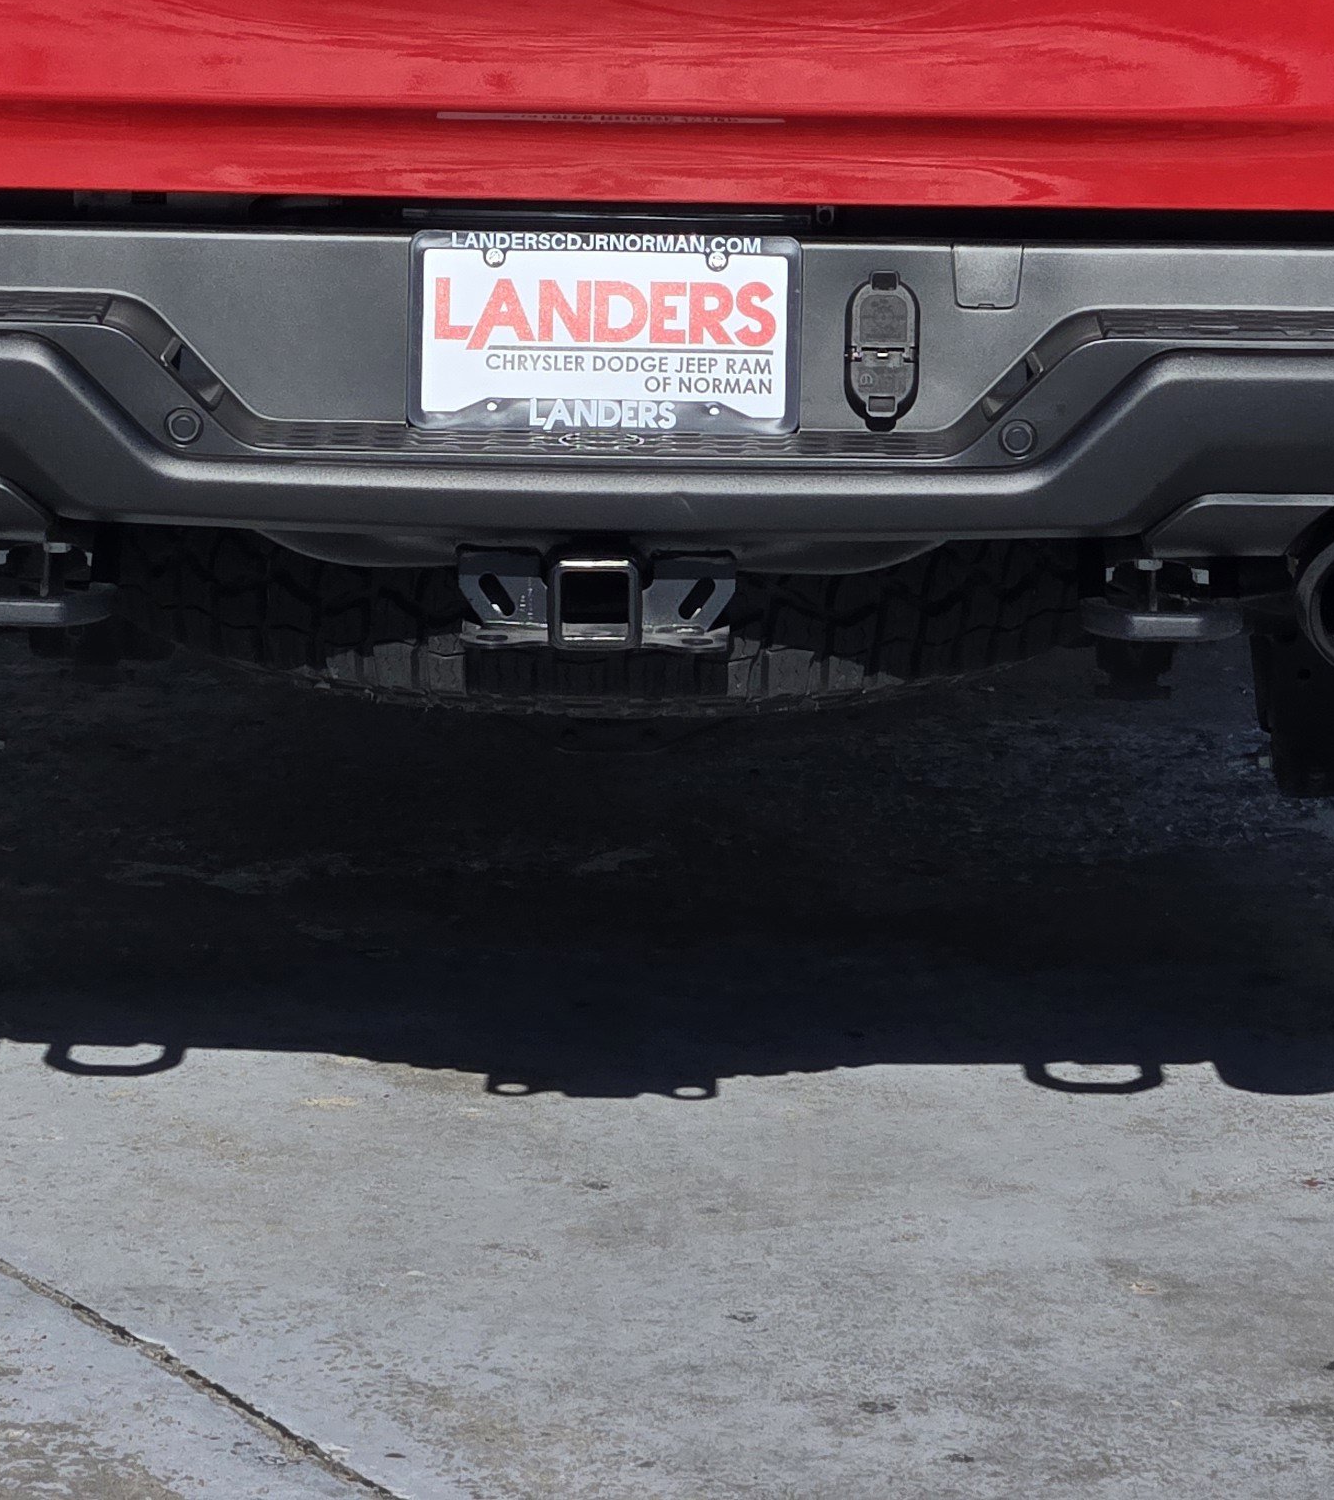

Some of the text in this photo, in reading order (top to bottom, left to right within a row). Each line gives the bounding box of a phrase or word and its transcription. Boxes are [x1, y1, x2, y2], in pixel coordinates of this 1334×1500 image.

[451, 231, 762, 255] LANDERSCDJRNORMAN.COM
[433, 276, 777, 351] LANDERS
[485, 353, 772, 375] CHRYSLER DODGE JEEP RAM
[644, 376, 773, 395] OF NORMAN
[528, 397, 677, 431] LANDERS
